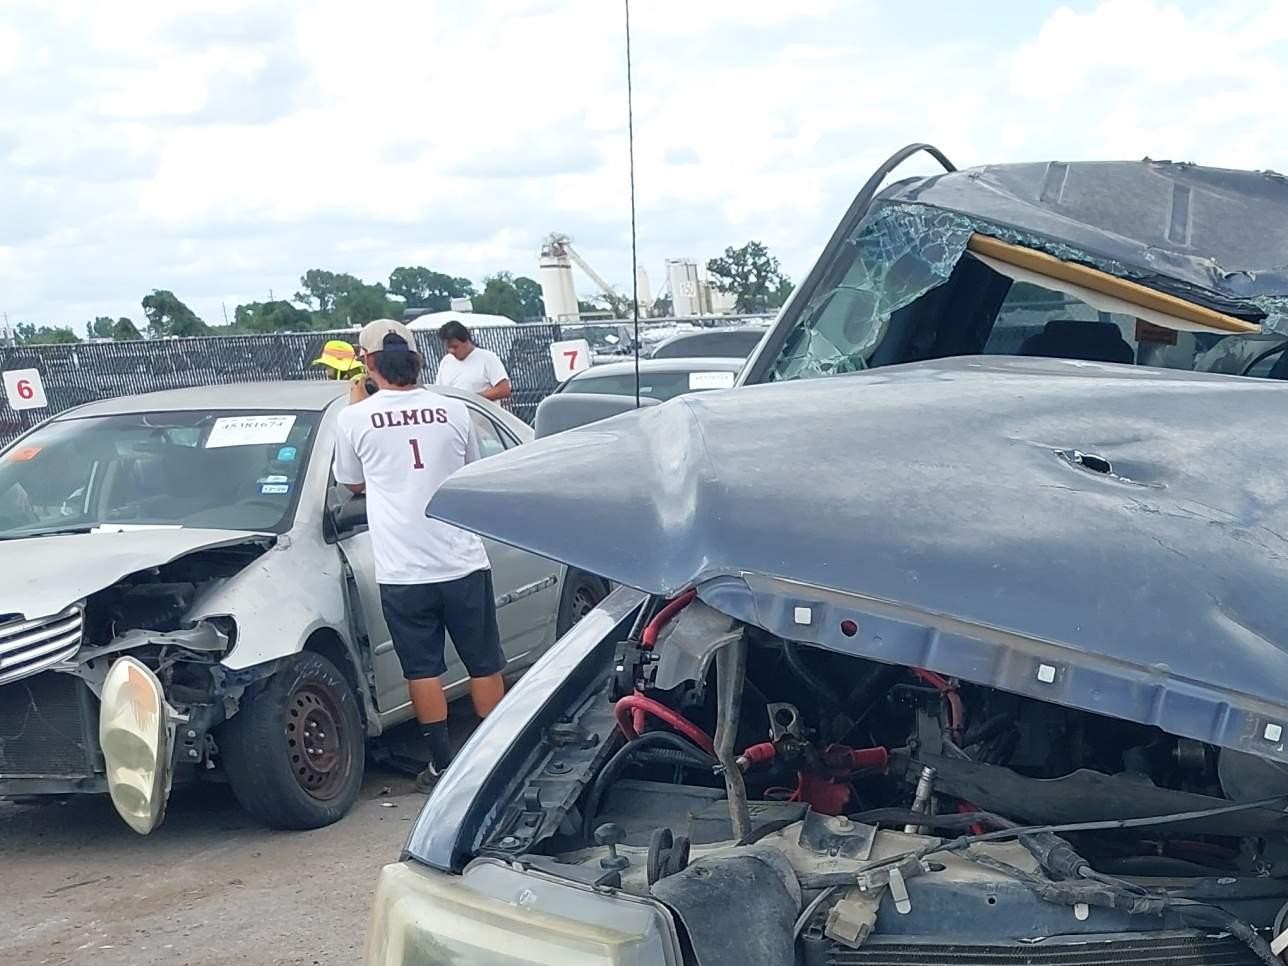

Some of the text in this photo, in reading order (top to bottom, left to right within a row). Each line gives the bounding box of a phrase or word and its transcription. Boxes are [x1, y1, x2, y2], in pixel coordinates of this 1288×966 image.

[563, 350, 578, 370] 7
[16, 379, 34, 400] 6
[370, 408, 448, 429] OLMOS
[409, 438, 424, 470] 1
